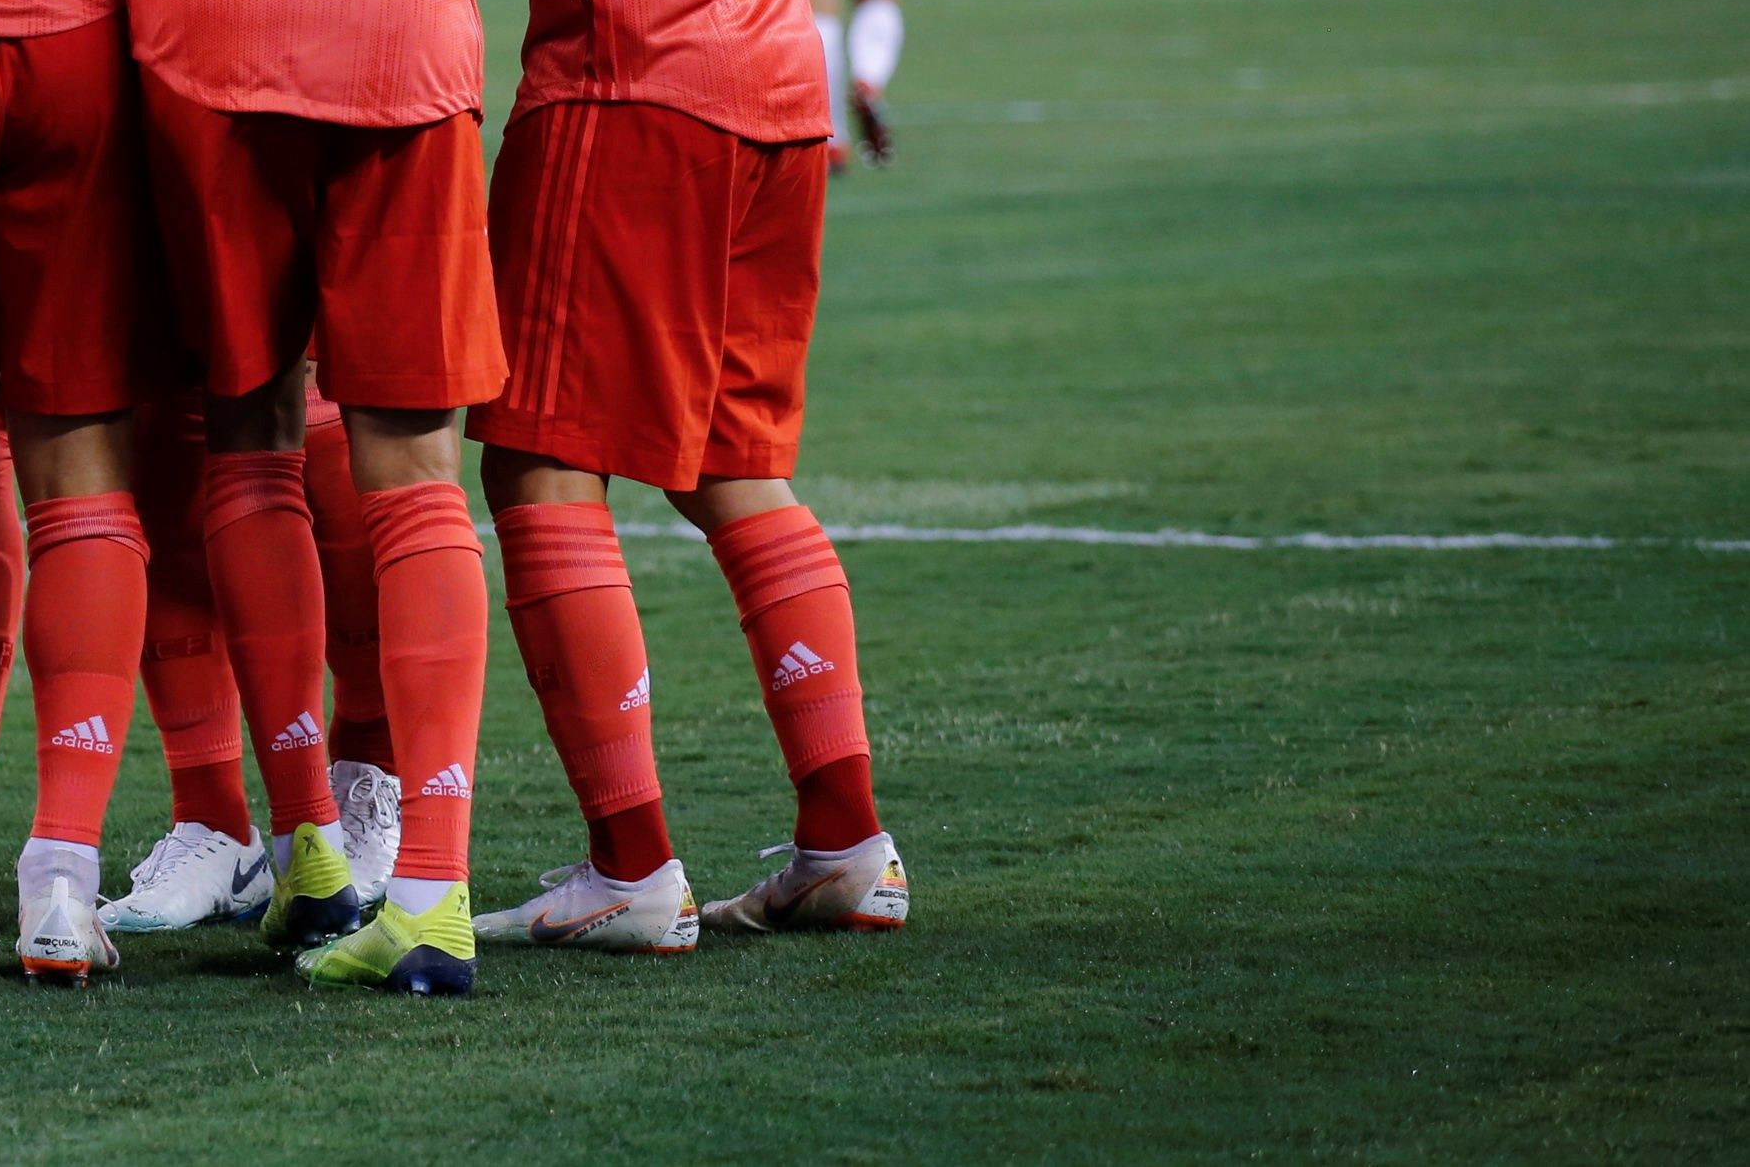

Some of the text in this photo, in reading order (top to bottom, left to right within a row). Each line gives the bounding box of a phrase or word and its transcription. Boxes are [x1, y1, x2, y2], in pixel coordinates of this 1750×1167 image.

[772, 661, 835, 691] adidas
[52, 734, 113, 754] adidas
[271, 733, 324, 752] adidas
[422, 783, 472, 800] adidas
